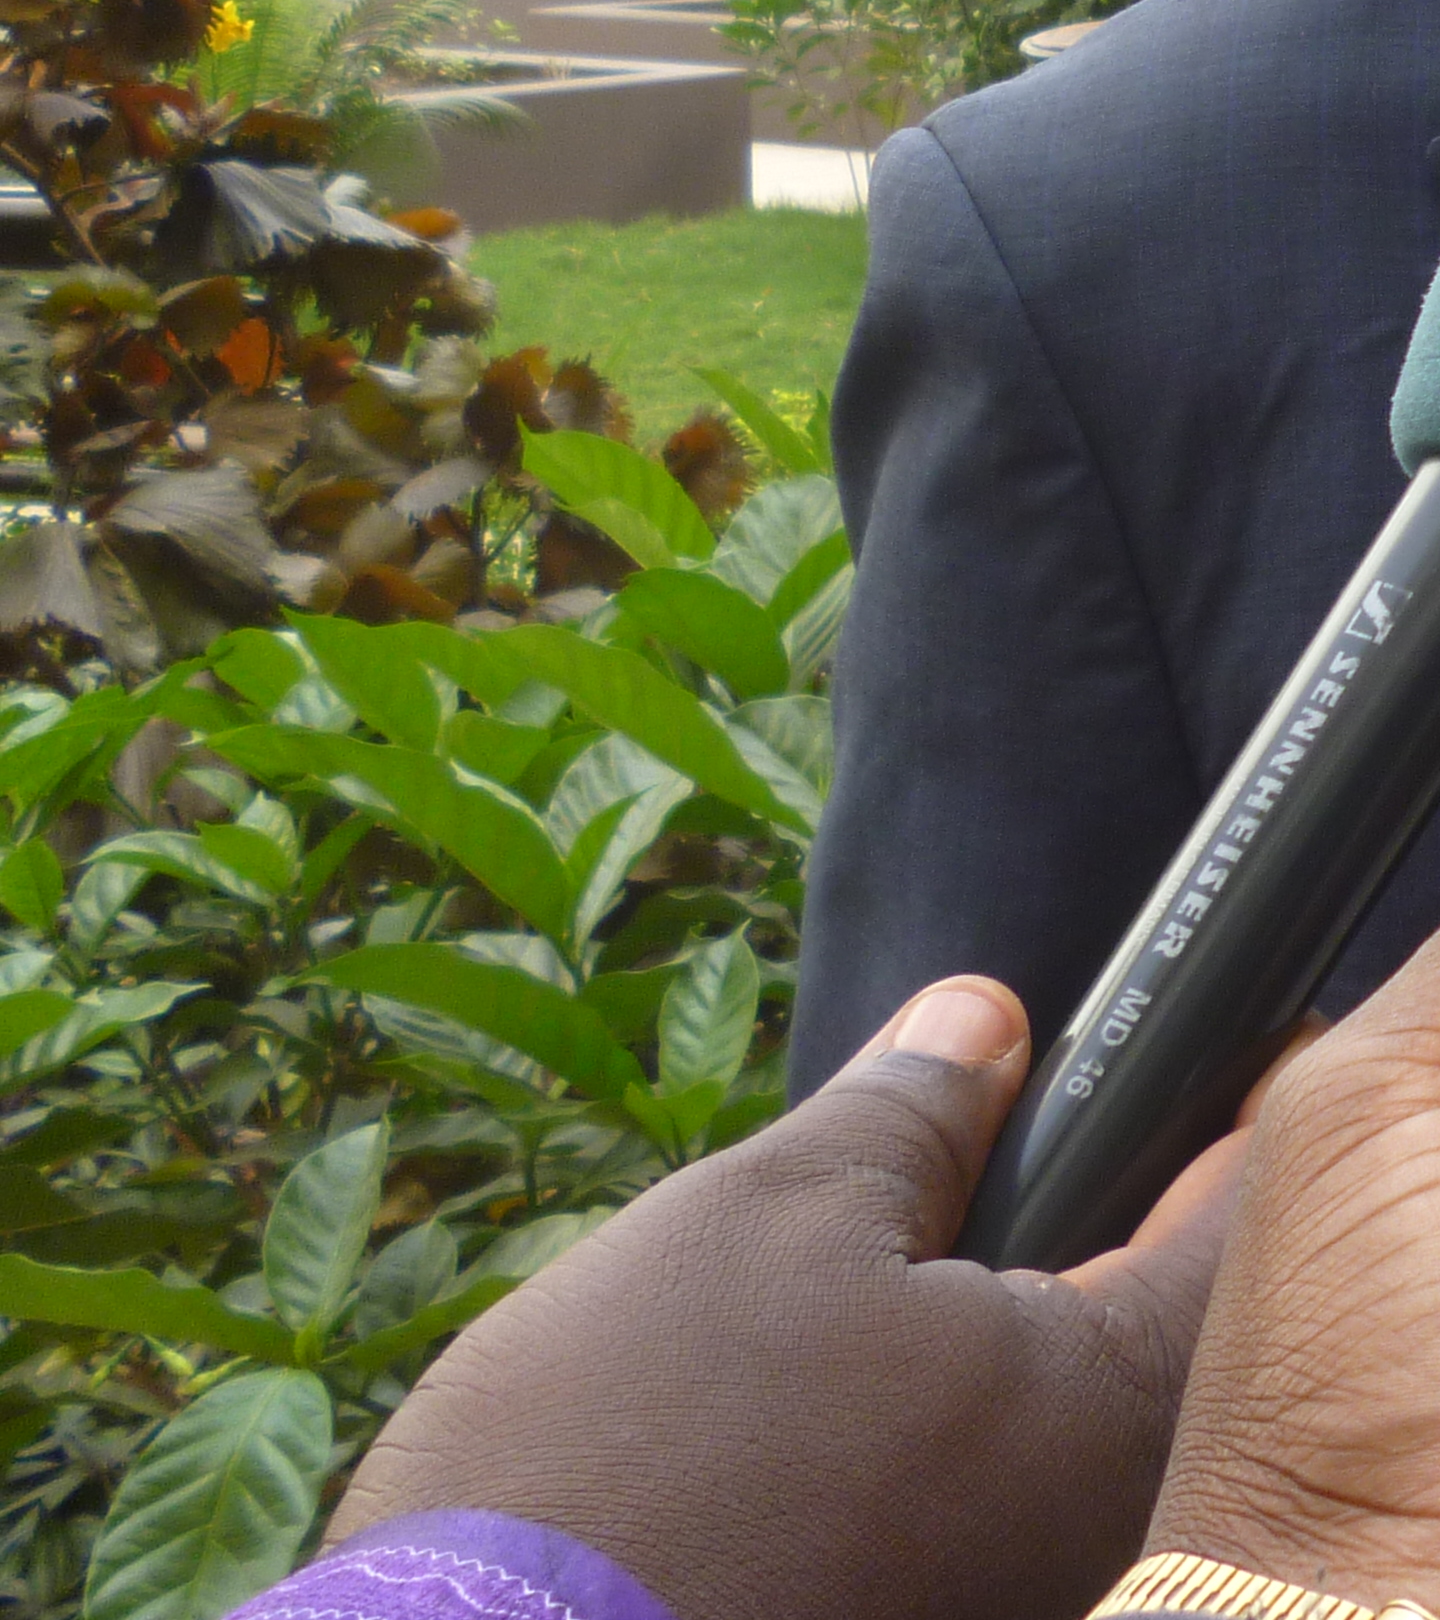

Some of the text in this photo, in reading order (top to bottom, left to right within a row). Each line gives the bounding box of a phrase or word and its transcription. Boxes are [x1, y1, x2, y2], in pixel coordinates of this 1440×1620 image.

[1153, 651, 1360, 959] SENNHEISER
[1101, 987, 1152, 1047] MD
[1065, 1057, 1105, 1100] 46
